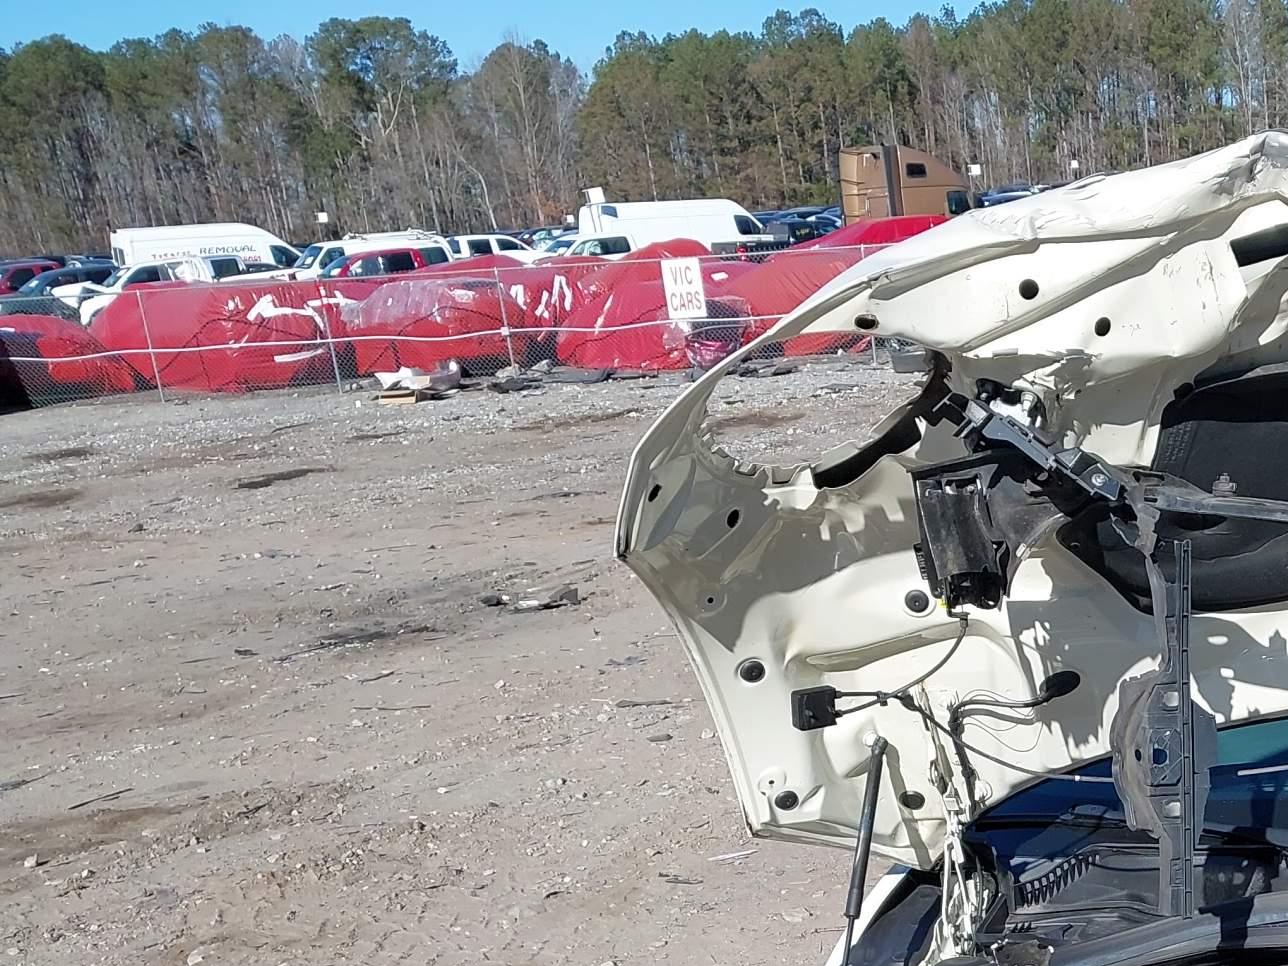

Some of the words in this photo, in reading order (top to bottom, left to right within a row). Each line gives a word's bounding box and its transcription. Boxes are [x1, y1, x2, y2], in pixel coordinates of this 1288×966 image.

[199, 244, 256, 255] REMOVAL
[670, 265, 693, 286] VIC
[670, 290, 703, 312] CARS
